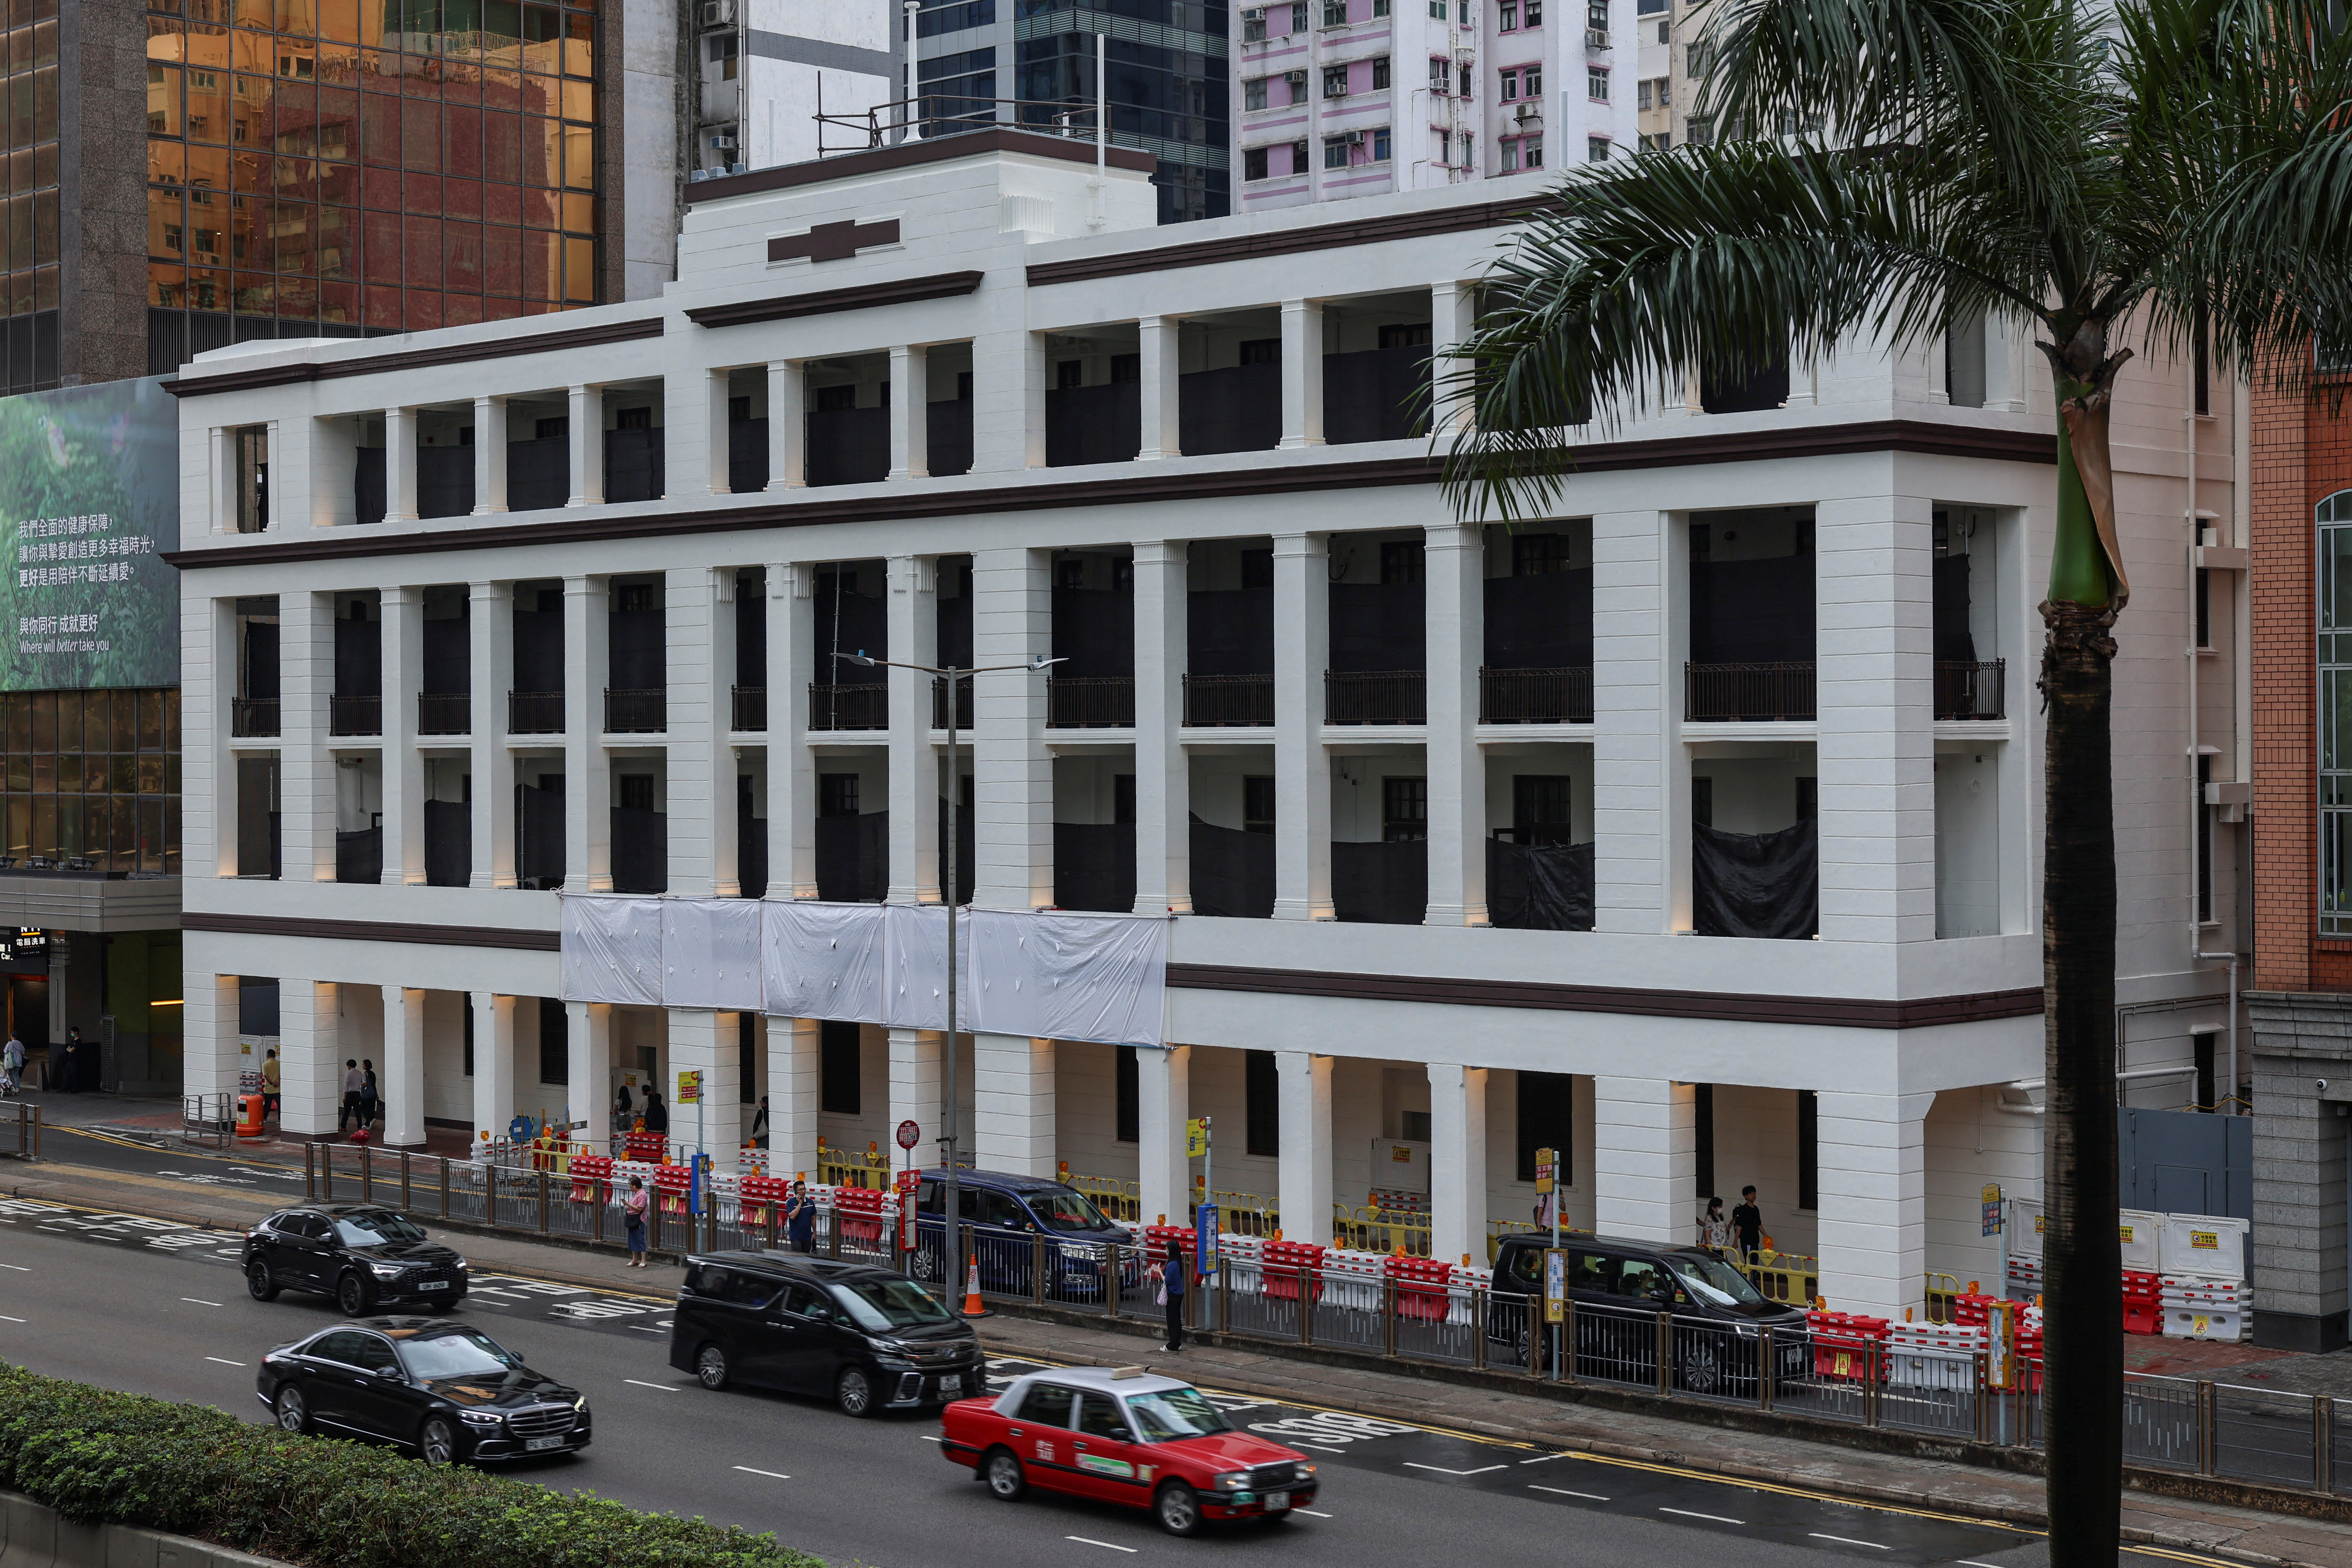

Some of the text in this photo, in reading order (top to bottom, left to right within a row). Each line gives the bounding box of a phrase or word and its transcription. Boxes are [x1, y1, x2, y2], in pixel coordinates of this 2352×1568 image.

[19, 513, 113, 539] 我們全面的健康保障，
[19, 534, 155, 563] 讓你與摯愛創造更多幸福時光，
[19, 561, 135, 588] 更好是用陪伴不斷延續愛。
[19, 613, 98, 635] 與你同行 成就更好
[20, 637, 110, 653] Where will better take you
[16, 937, 46, 947] 電腦洗車
